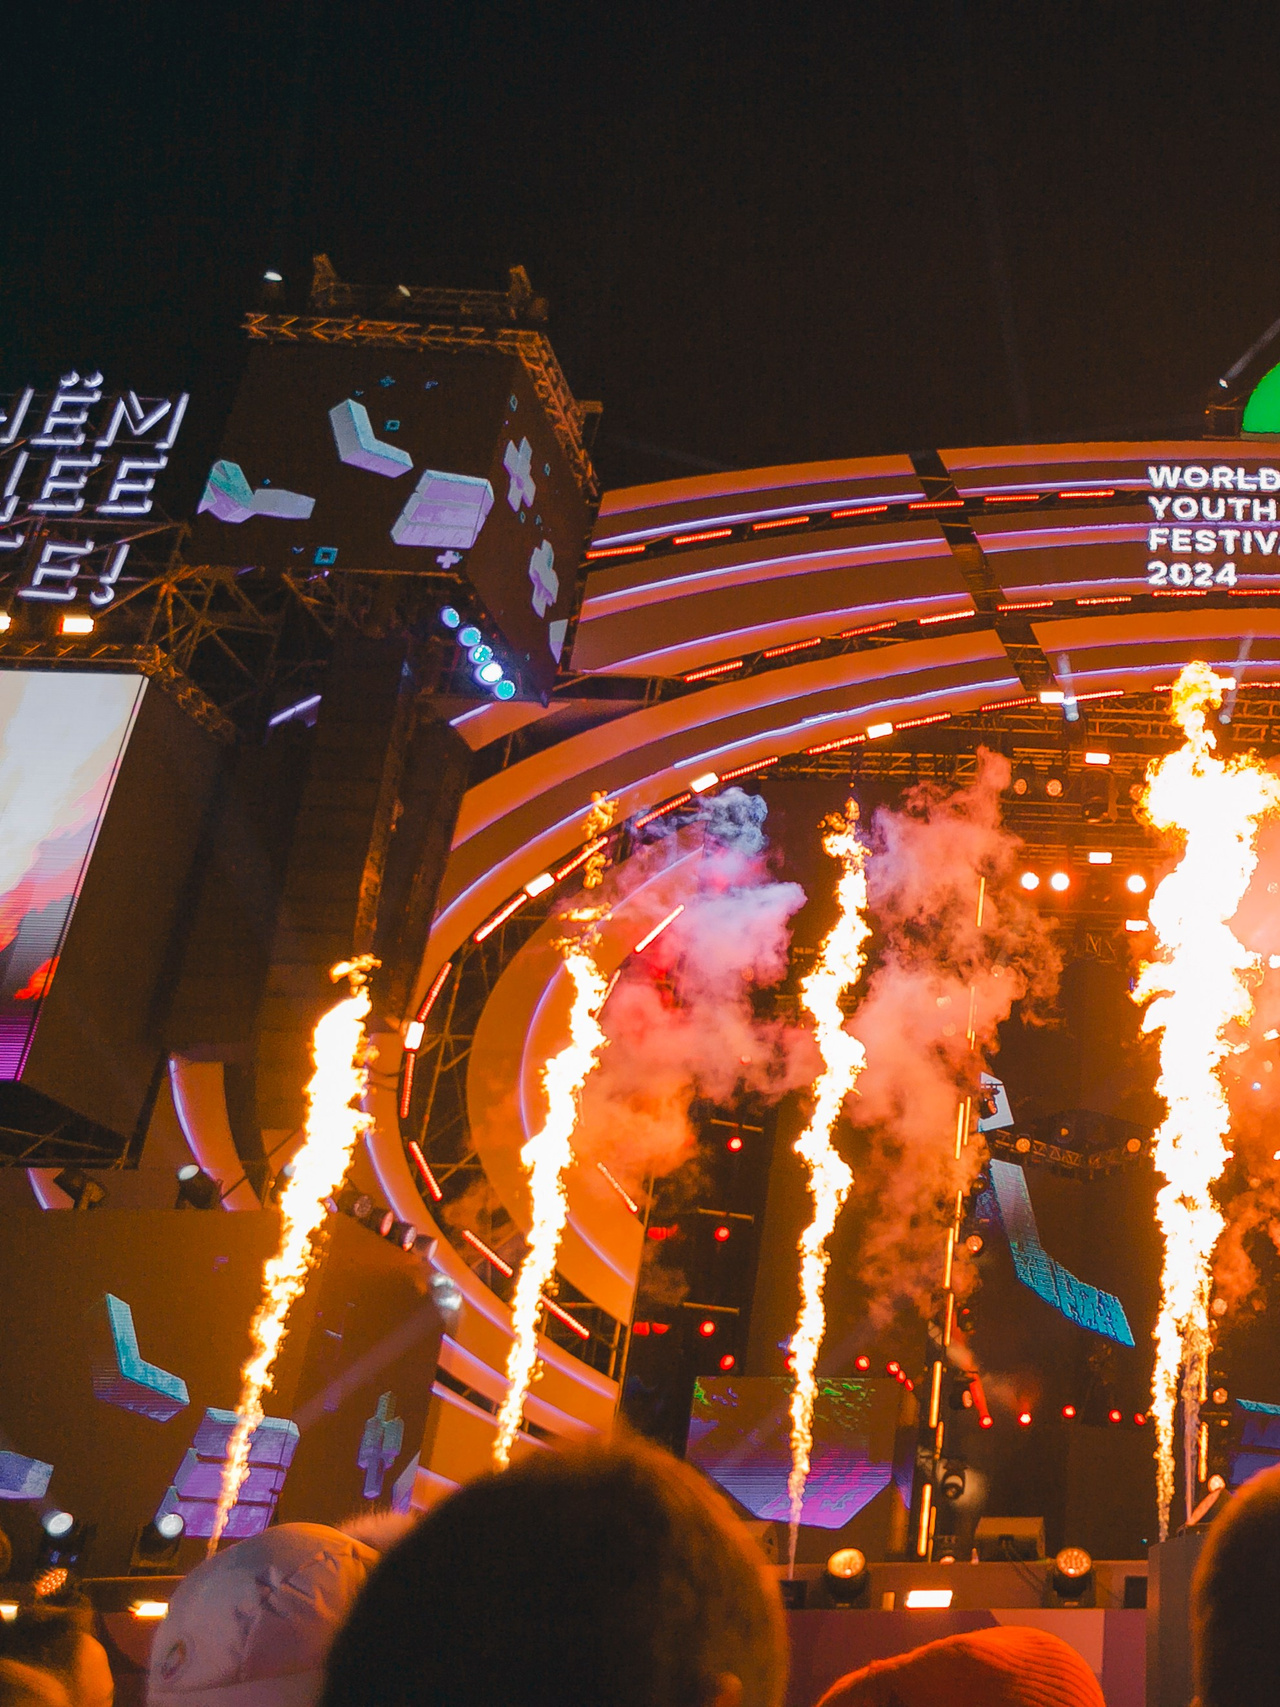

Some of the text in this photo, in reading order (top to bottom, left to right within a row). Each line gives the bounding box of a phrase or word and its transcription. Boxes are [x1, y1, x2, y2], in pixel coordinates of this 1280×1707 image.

[0, 370, 190, 450] ЁМ
[0, 451, 169, 523] ЕЕ
[1148, 496, 1277, 522] YOUTH
[1147, 560, 1238, 588] 2024
